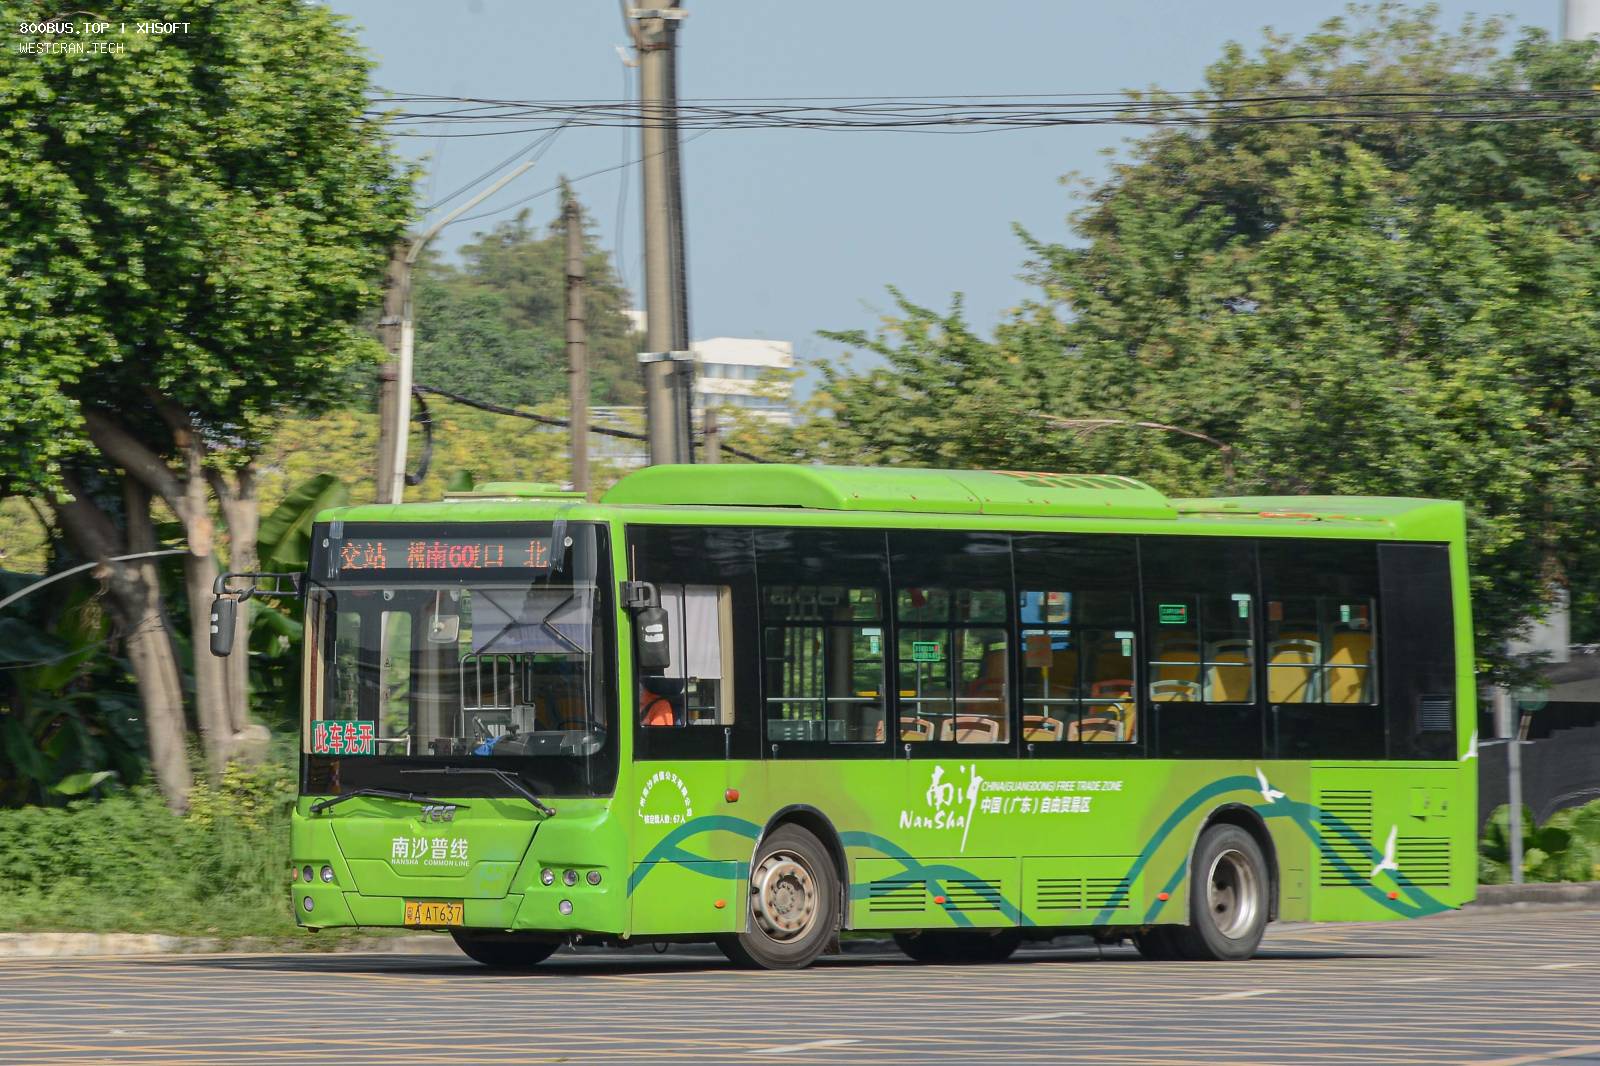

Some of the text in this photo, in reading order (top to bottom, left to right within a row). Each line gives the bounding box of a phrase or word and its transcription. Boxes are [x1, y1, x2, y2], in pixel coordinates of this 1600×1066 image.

[314, 722, 373, 755] 此车先开
[1056, 781, 1074, 791] FREE
[1077, 780, 1101, 791] TRADE
[1101, 780, 1124, 791] ZONE
[391, 836, 469, 860] 南沙普线
